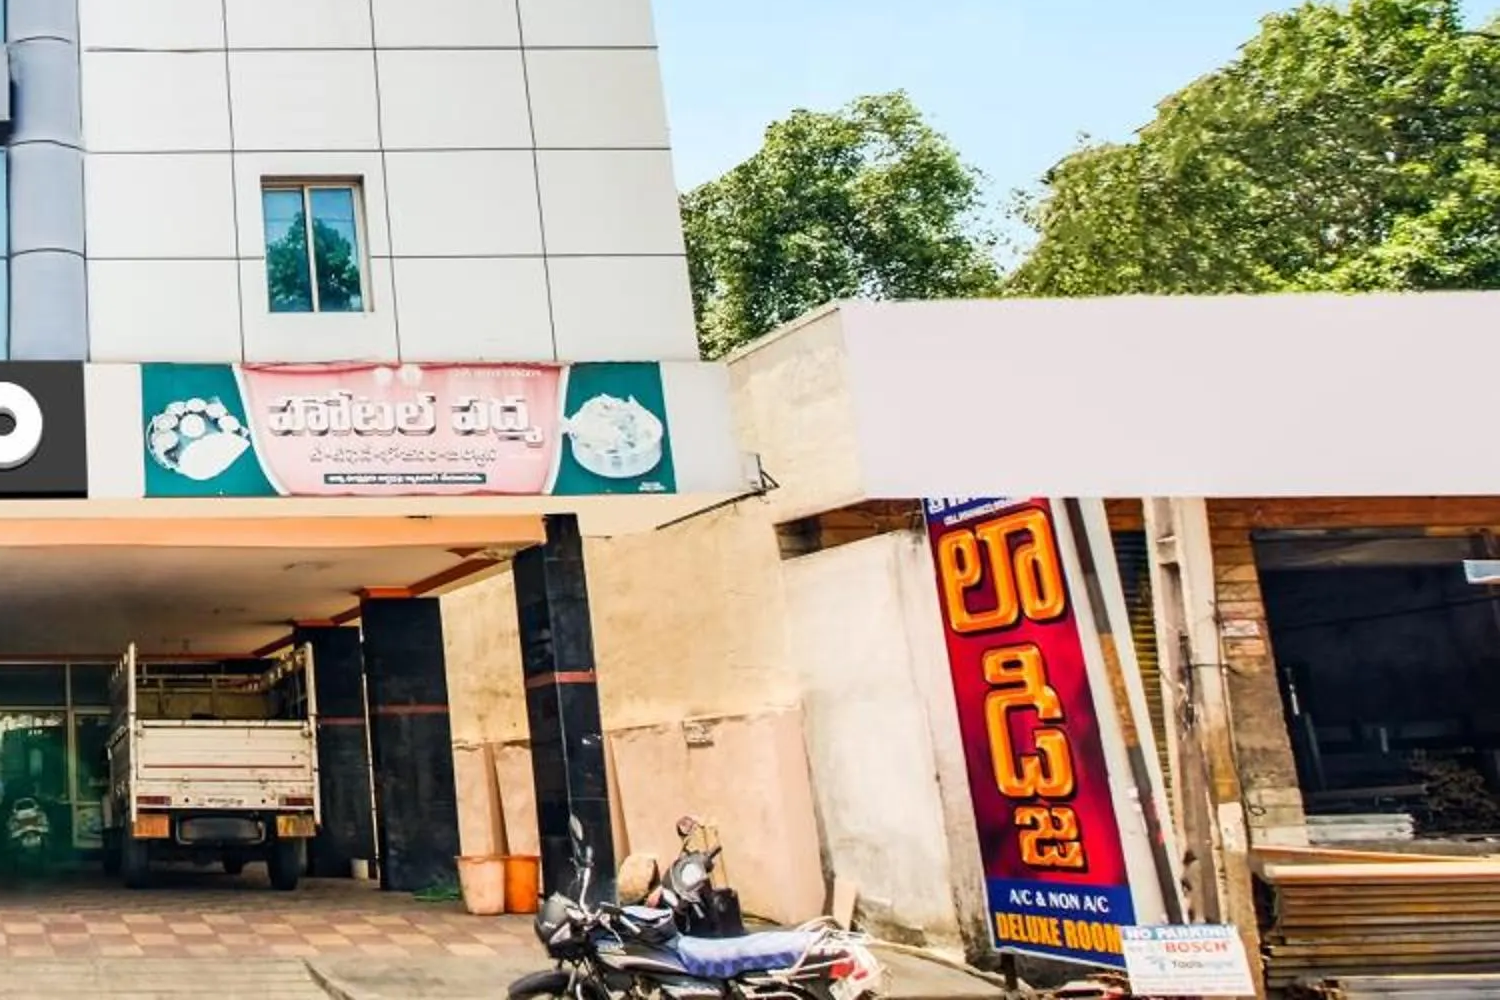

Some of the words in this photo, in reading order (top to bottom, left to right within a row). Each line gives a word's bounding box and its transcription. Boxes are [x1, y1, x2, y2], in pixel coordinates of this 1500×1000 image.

[1009, 888, 1033, 906] A/C
[1035, 890, 1047, 907] &
[1049, 891, 1080, 910] NON
[1083, 895, 1110, 913] A/C
[995, 911, 1062, 947] DELUXE
[1165, 941, 1229, 953] BOSCH
